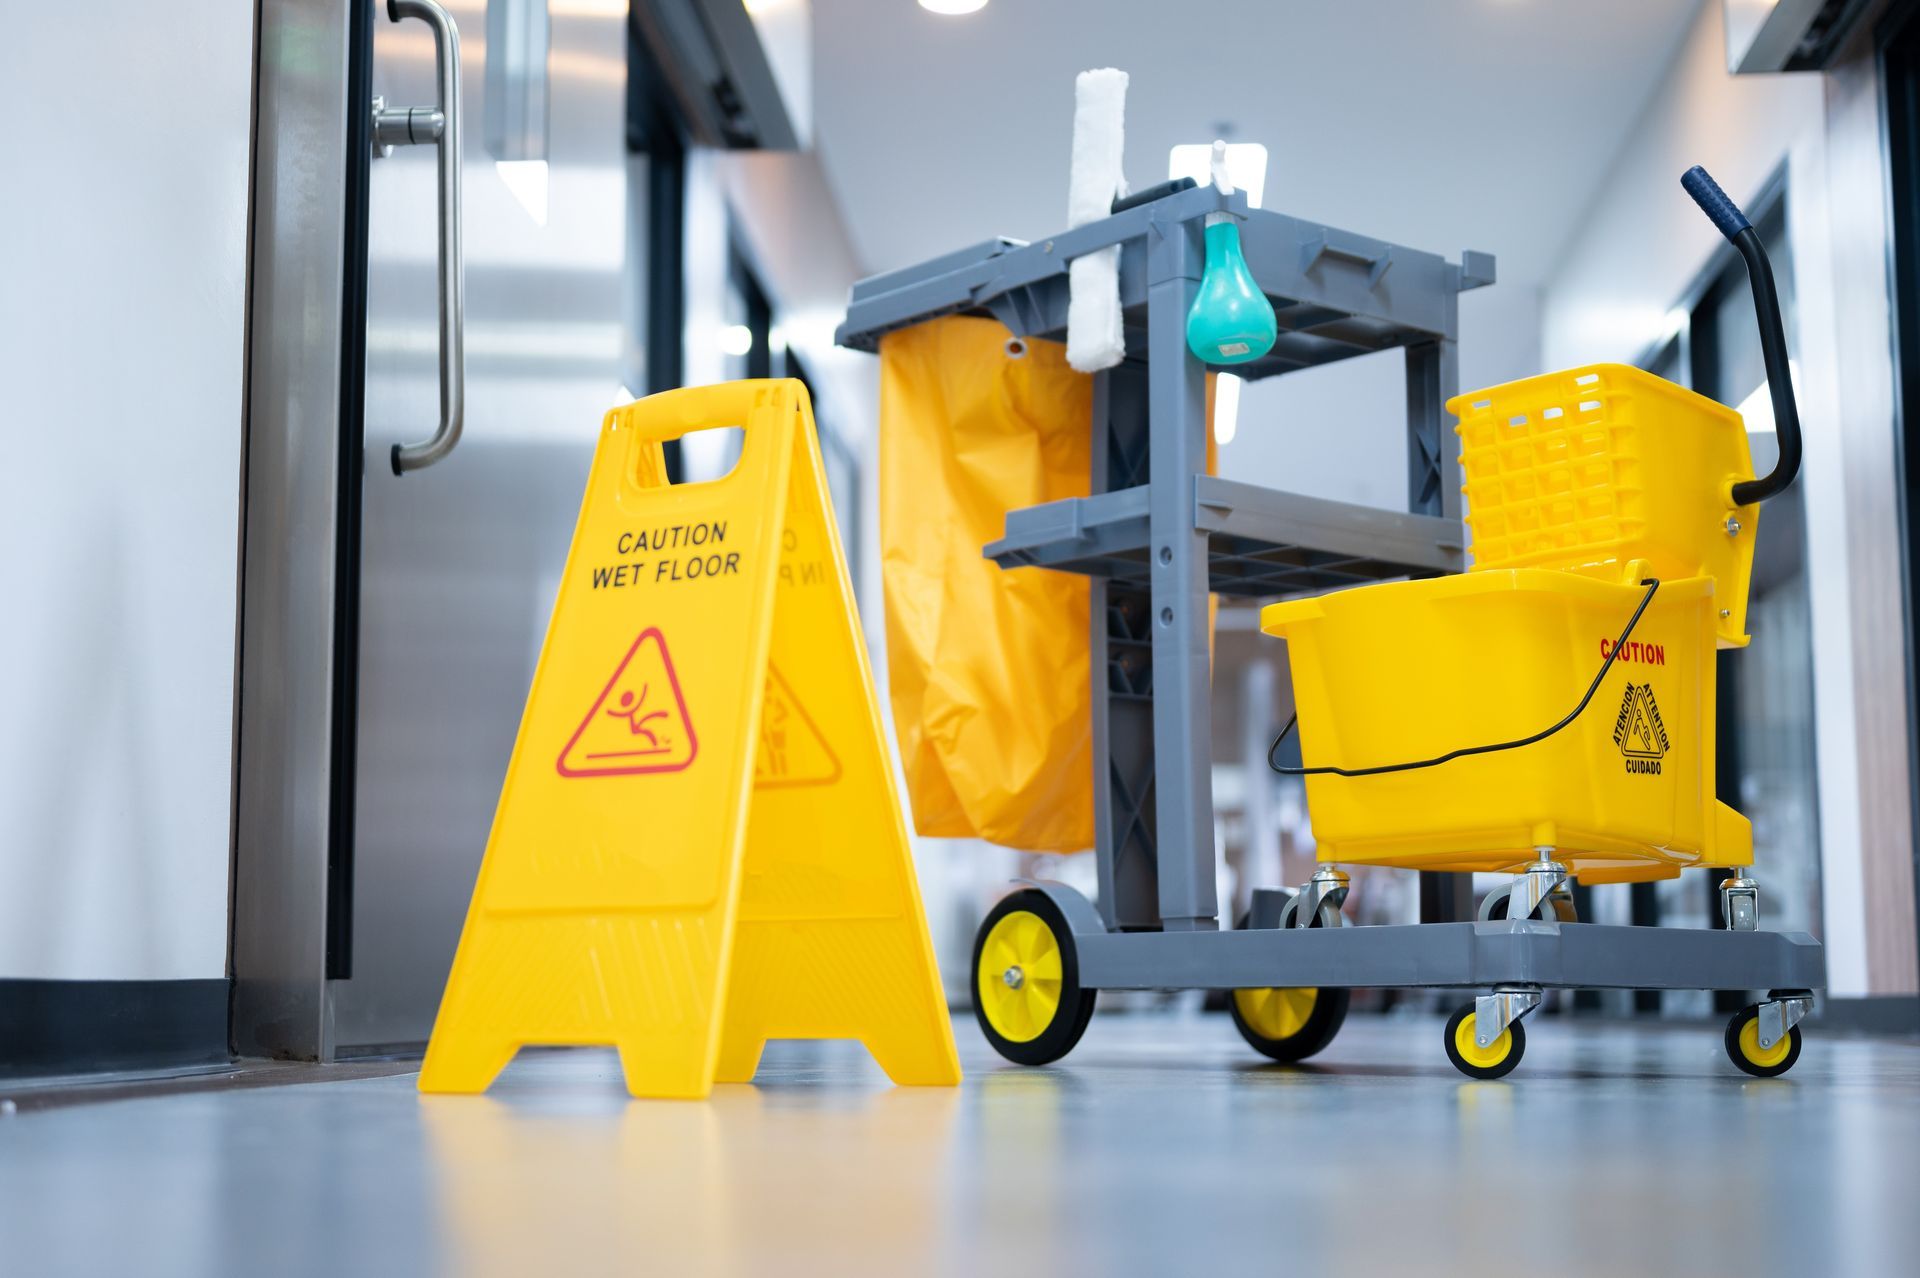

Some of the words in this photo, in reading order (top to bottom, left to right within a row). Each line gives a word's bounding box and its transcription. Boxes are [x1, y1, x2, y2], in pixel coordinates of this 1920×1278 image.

[618, 521, 727, 554] CAUTION
[592, 564, 644, 589] WET
[655, 552, 740, 582] FLOOR
[1612, 682, 1635, 746] ATENCION
[1643, 683, 1670, 752] ATTENTION
[1626, 759, 1661, 775] CUIDADO
